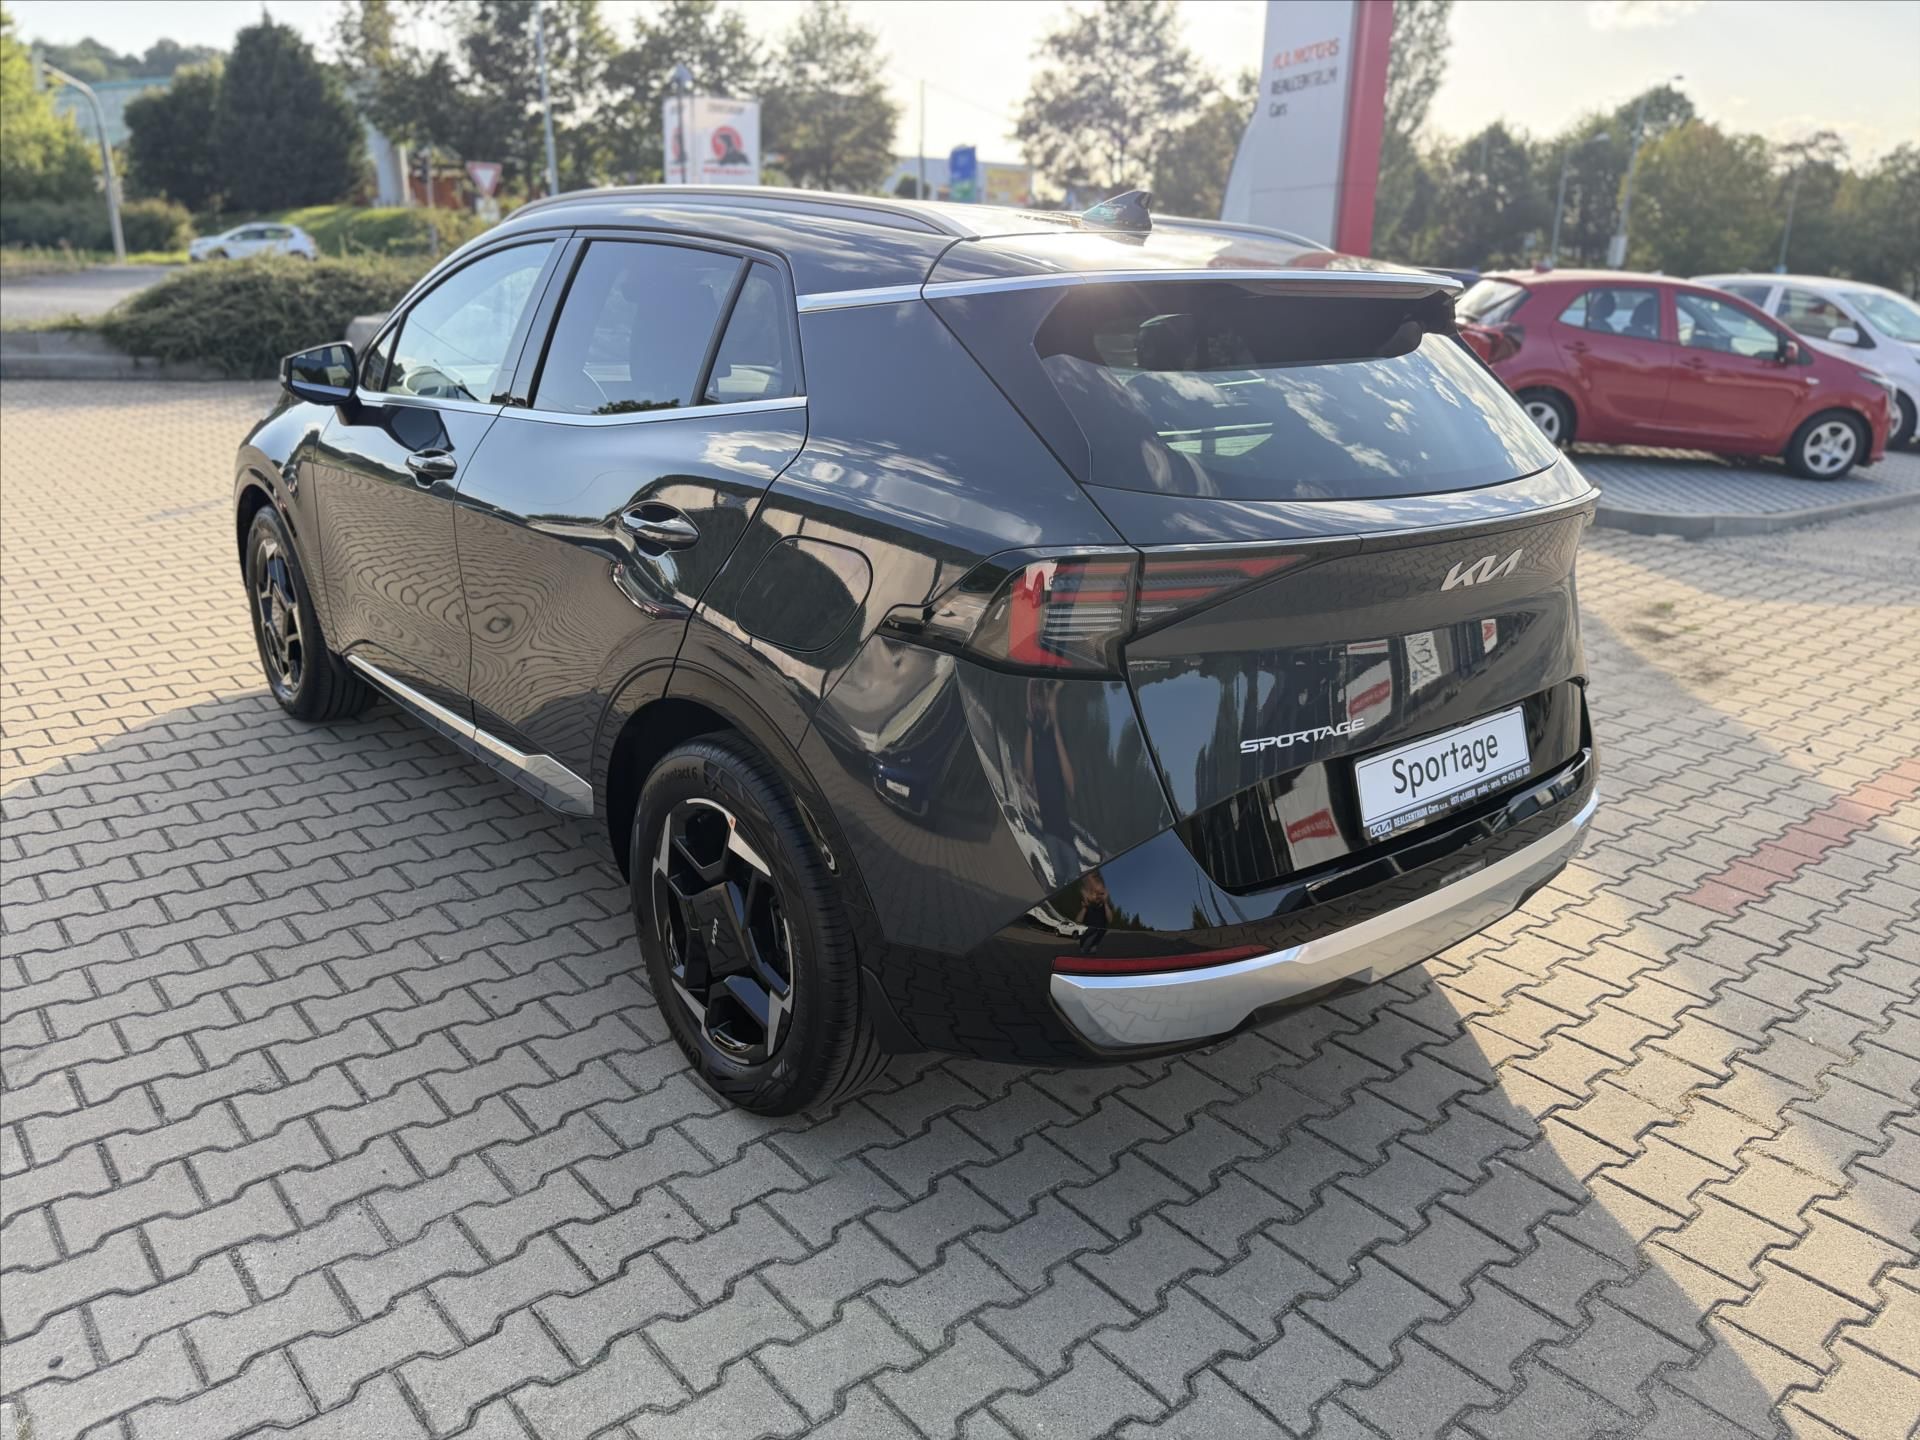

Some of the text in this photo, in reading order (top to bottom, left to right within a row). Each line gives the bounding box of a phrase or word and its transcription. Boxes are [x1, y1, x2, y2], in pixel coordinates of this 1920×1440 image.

[1440, 548, 1523, 592] KIA
[1240, 718, 1366, 754] SPORTAGE
[1392, 733, 1499, 799] Sportage
